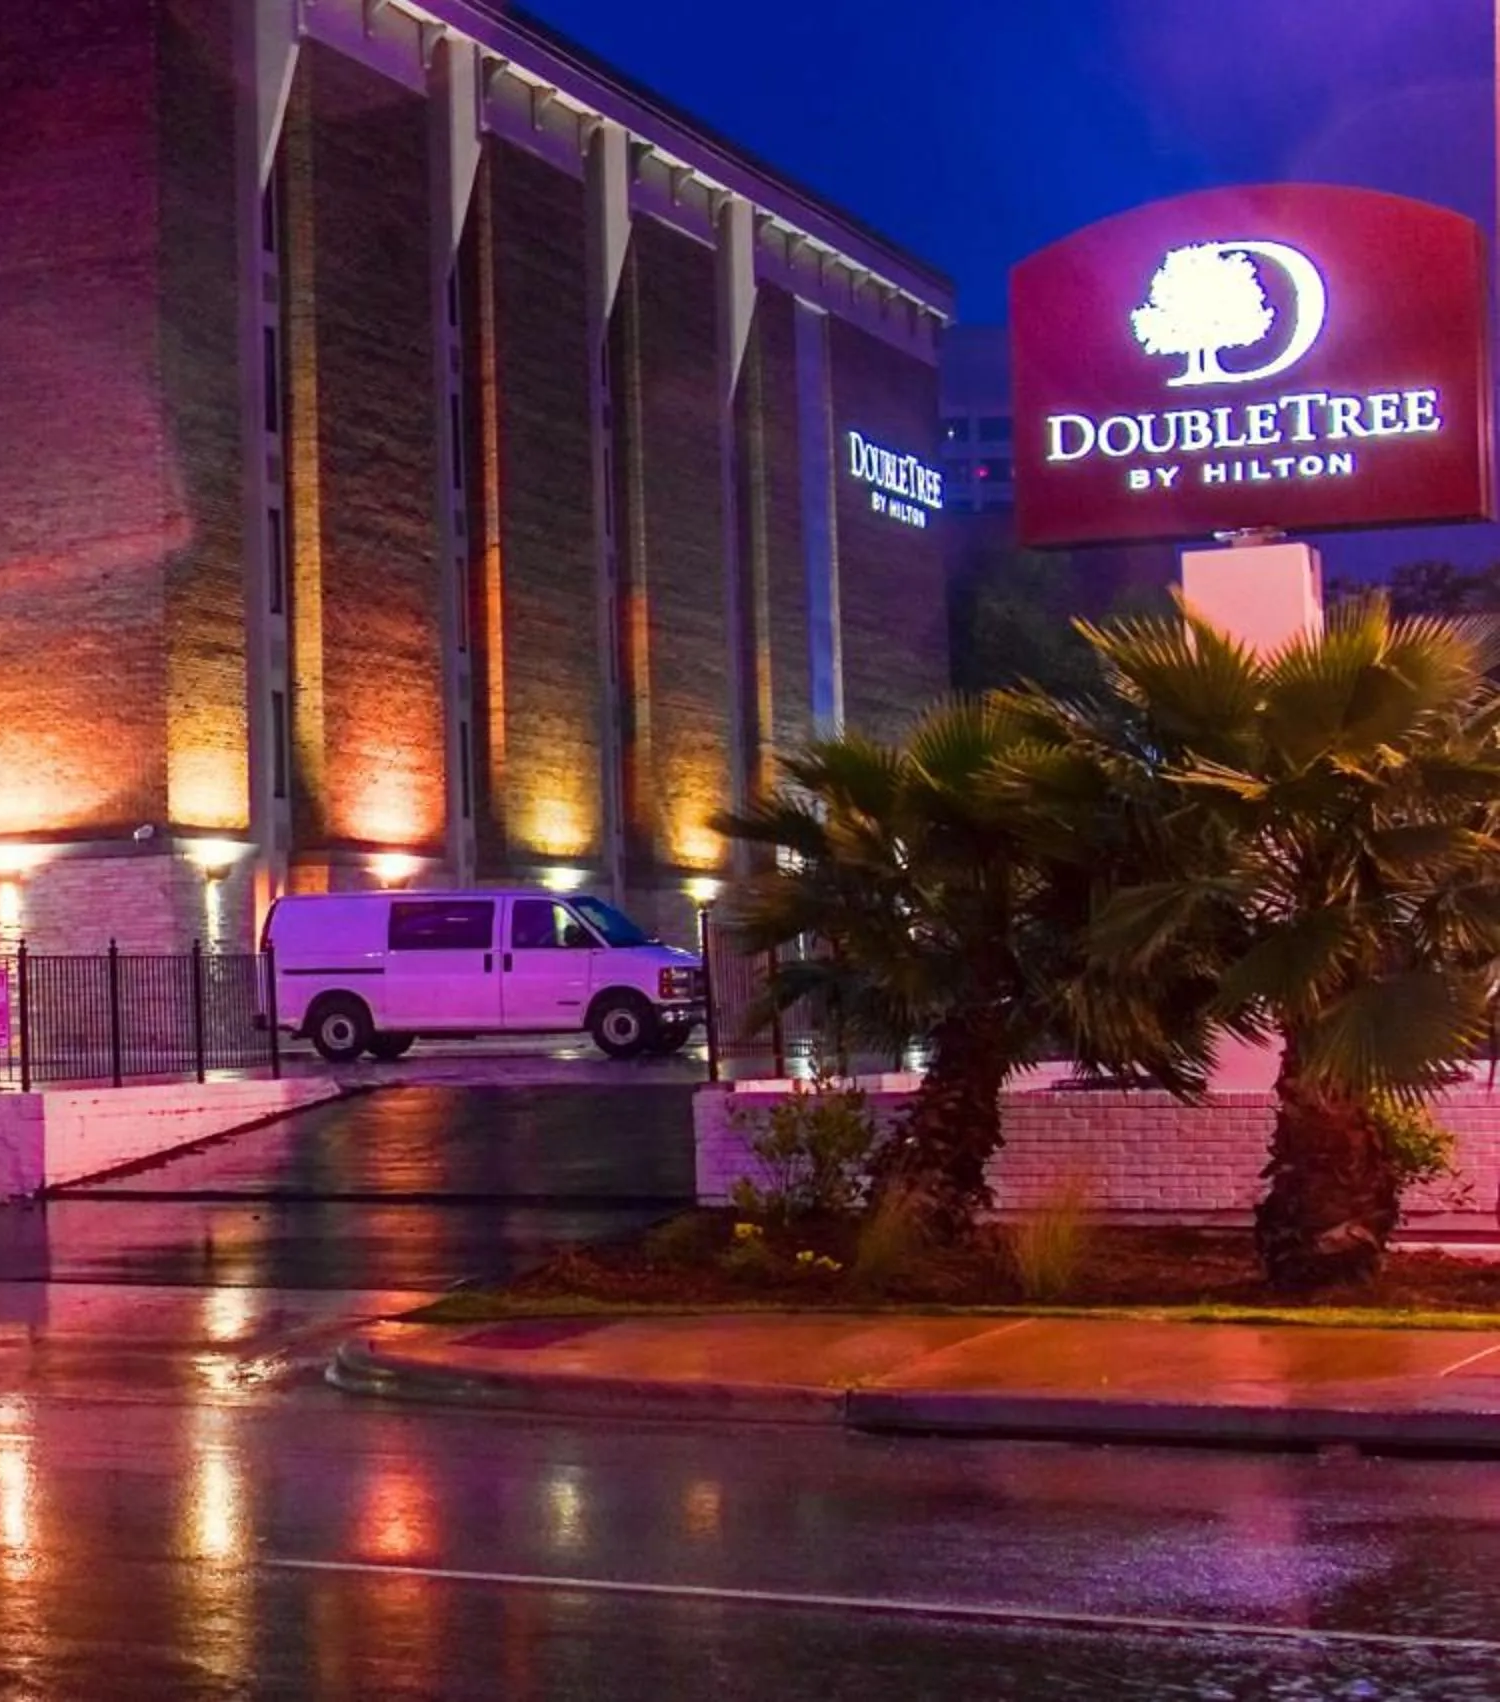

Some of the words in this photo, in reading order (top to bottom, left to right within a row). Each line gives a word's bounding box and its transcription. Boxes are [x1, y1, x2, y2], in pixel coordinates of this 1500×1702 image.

[1046, 389, 1441, 462] DOUBLETREE
[848, 431, 943, 508] DOUBLETREE
[1129, 466, 1179, 489] BY
[1203, 452, 1353, 483] HILTON
[871, 491, 886, 513] BY
